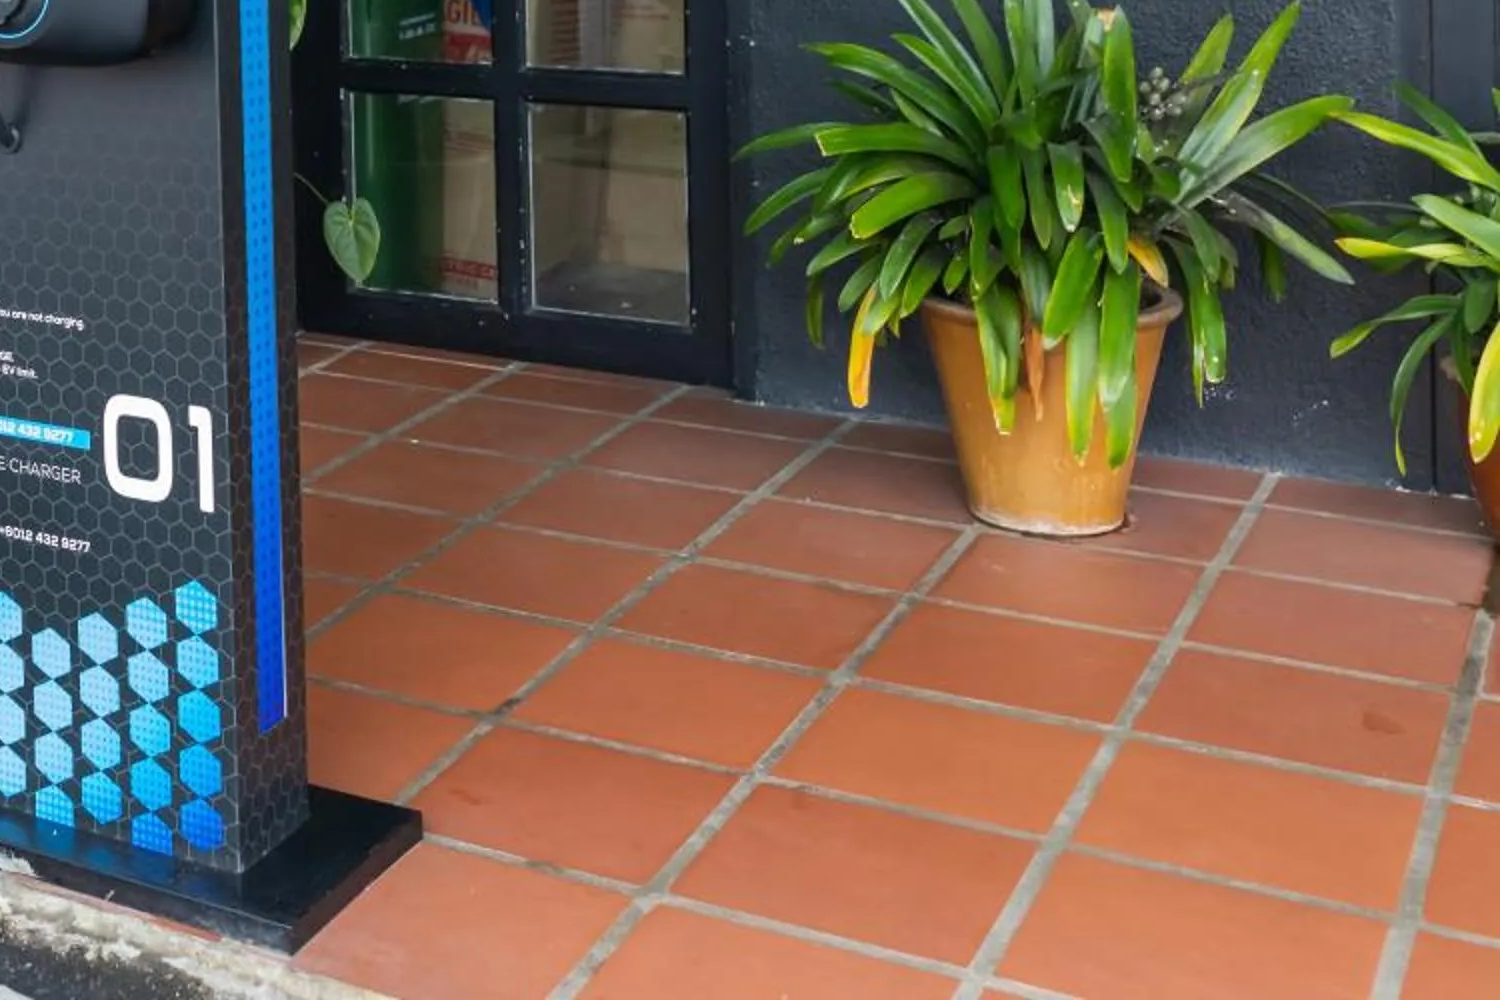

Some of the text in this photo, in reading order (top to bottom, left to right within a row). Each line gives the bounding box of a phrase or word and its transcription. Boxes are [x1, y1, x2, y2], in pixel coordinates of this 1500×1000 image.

[11, 310, 27, 320] are
[27, 312, 43, 323] not
[103, 393, 215, 513] 01
[8, 457, 82, 485] CHARGER
[35, 531, 60, 548] 432
[61, 536, 91, 553] 9277
